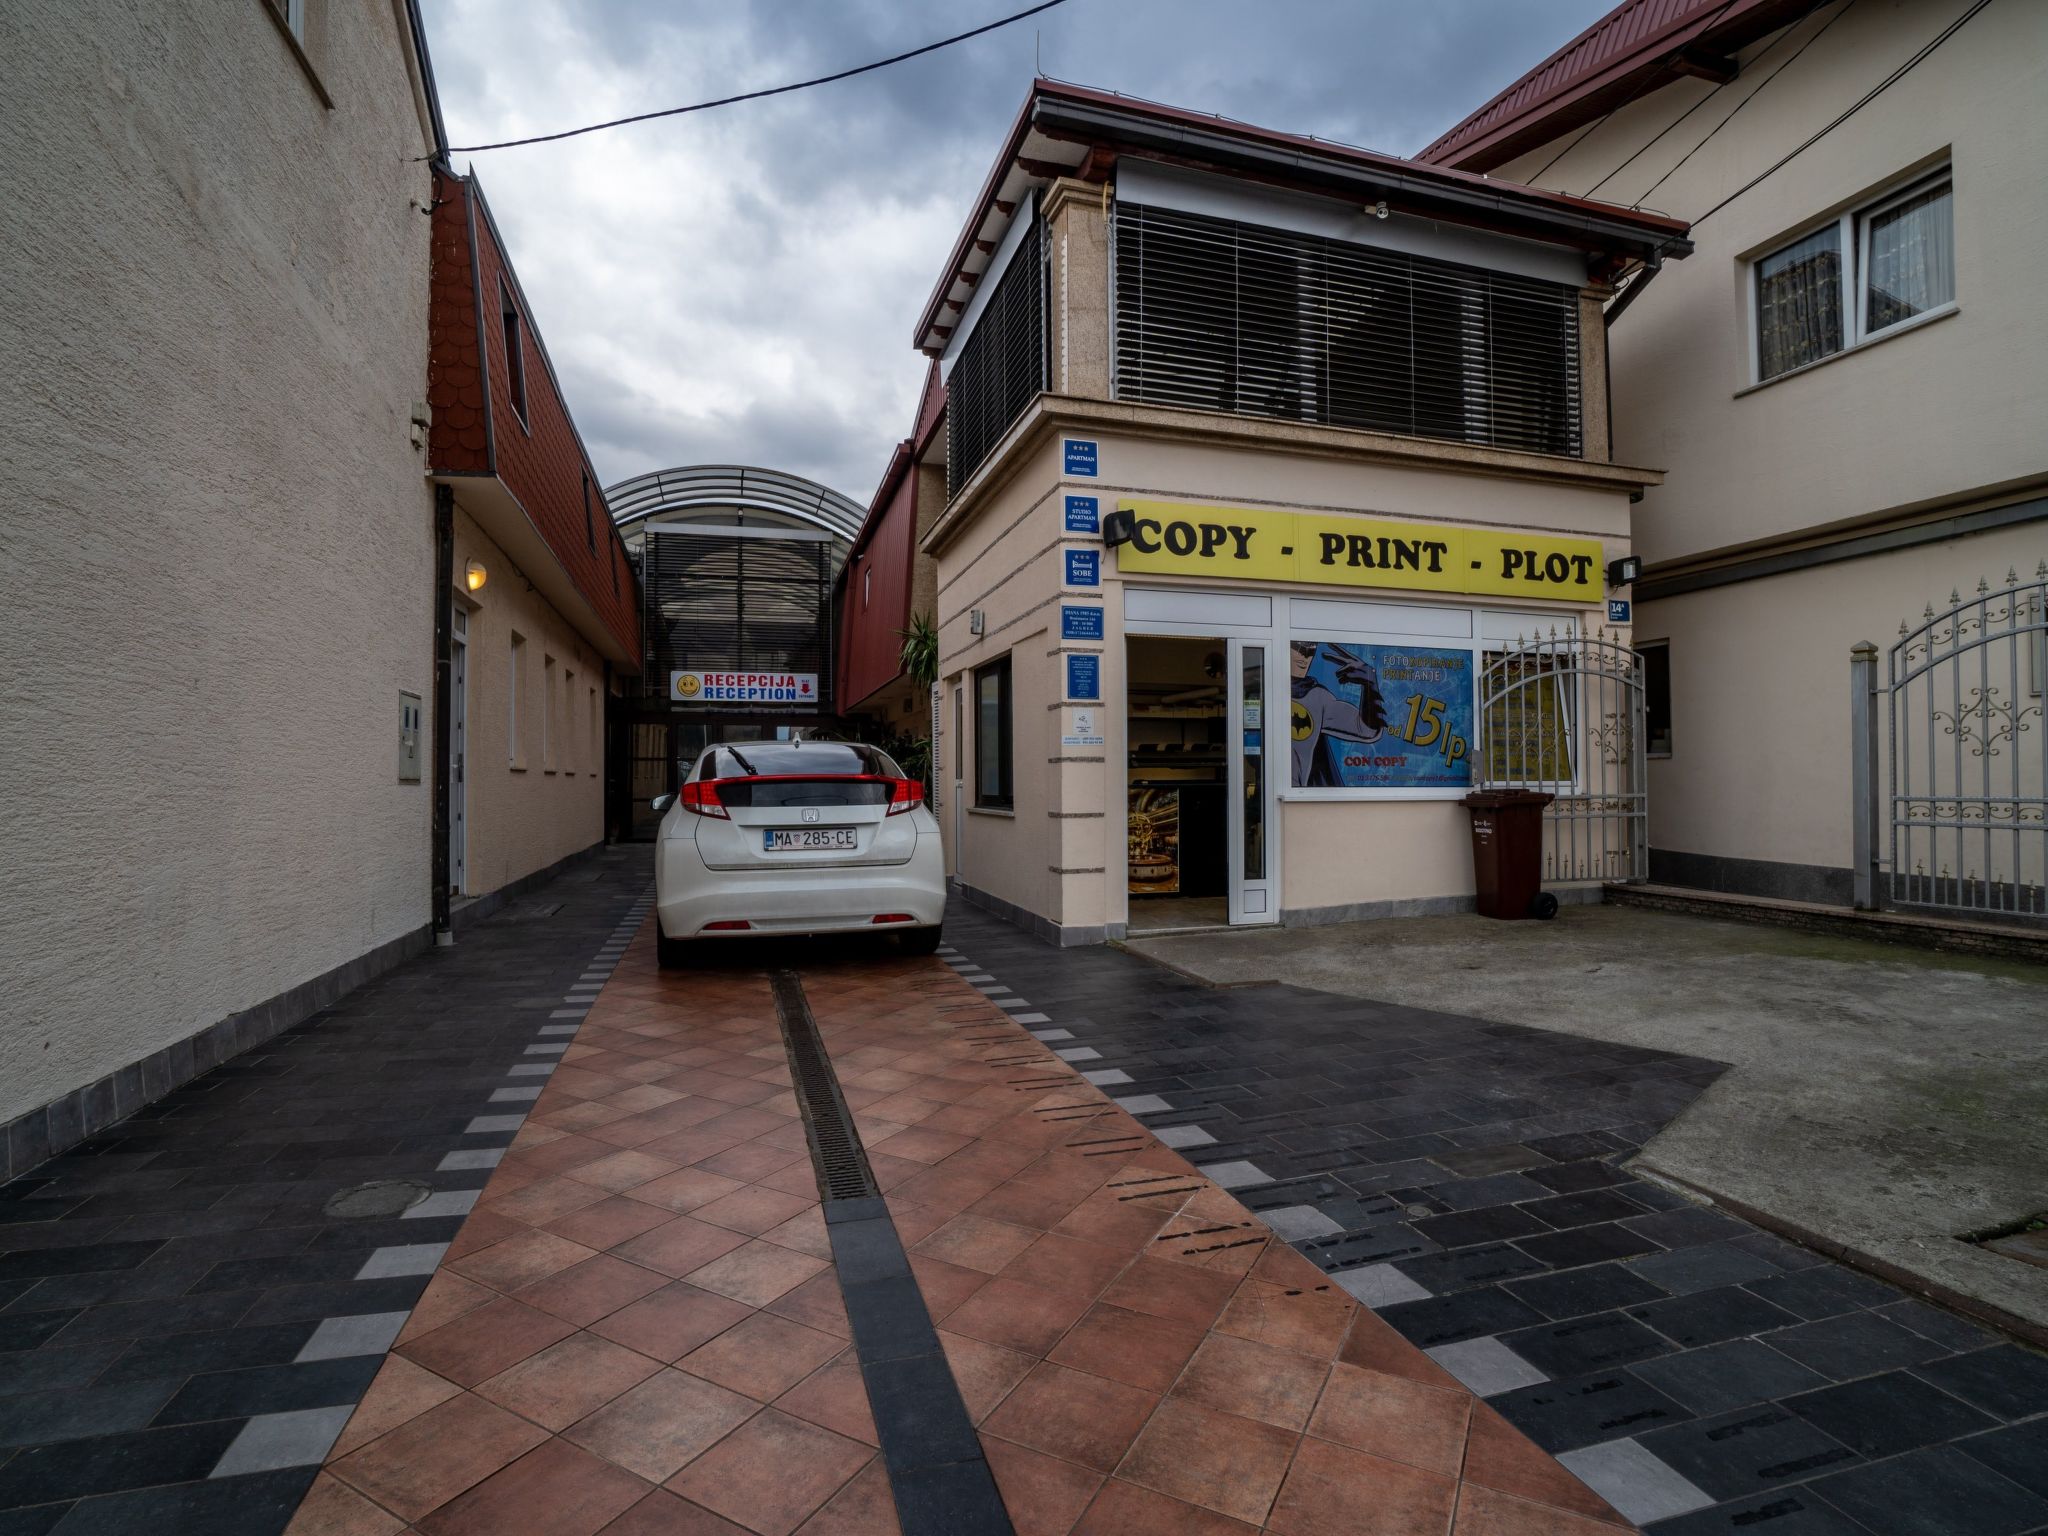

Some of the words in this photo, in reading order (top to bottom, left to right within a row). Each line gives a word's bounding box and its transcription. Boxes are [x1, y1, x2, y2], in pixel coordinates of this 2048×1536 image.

[1132, 518, 1257, 560] COPY
[1318, 532, 1448, 573] PRINT
[1500, 548, 1593, 585] PLOT
[1072, 569, 1093, 577] SOBE
[704, 674, 796, 688] RECEPCIJA
[1383, 668, 1442, 683] PRINTANJE
[704, 687, 797, 700] RECEPTION
[1403, 693, 1447, 747] 15
[1344, 756, 1374, 767] CON
[1374, 756, 1408, 768] COPY
[775, 832, 793, 846] MA
[803, 831, 854, 846] 285-CE
